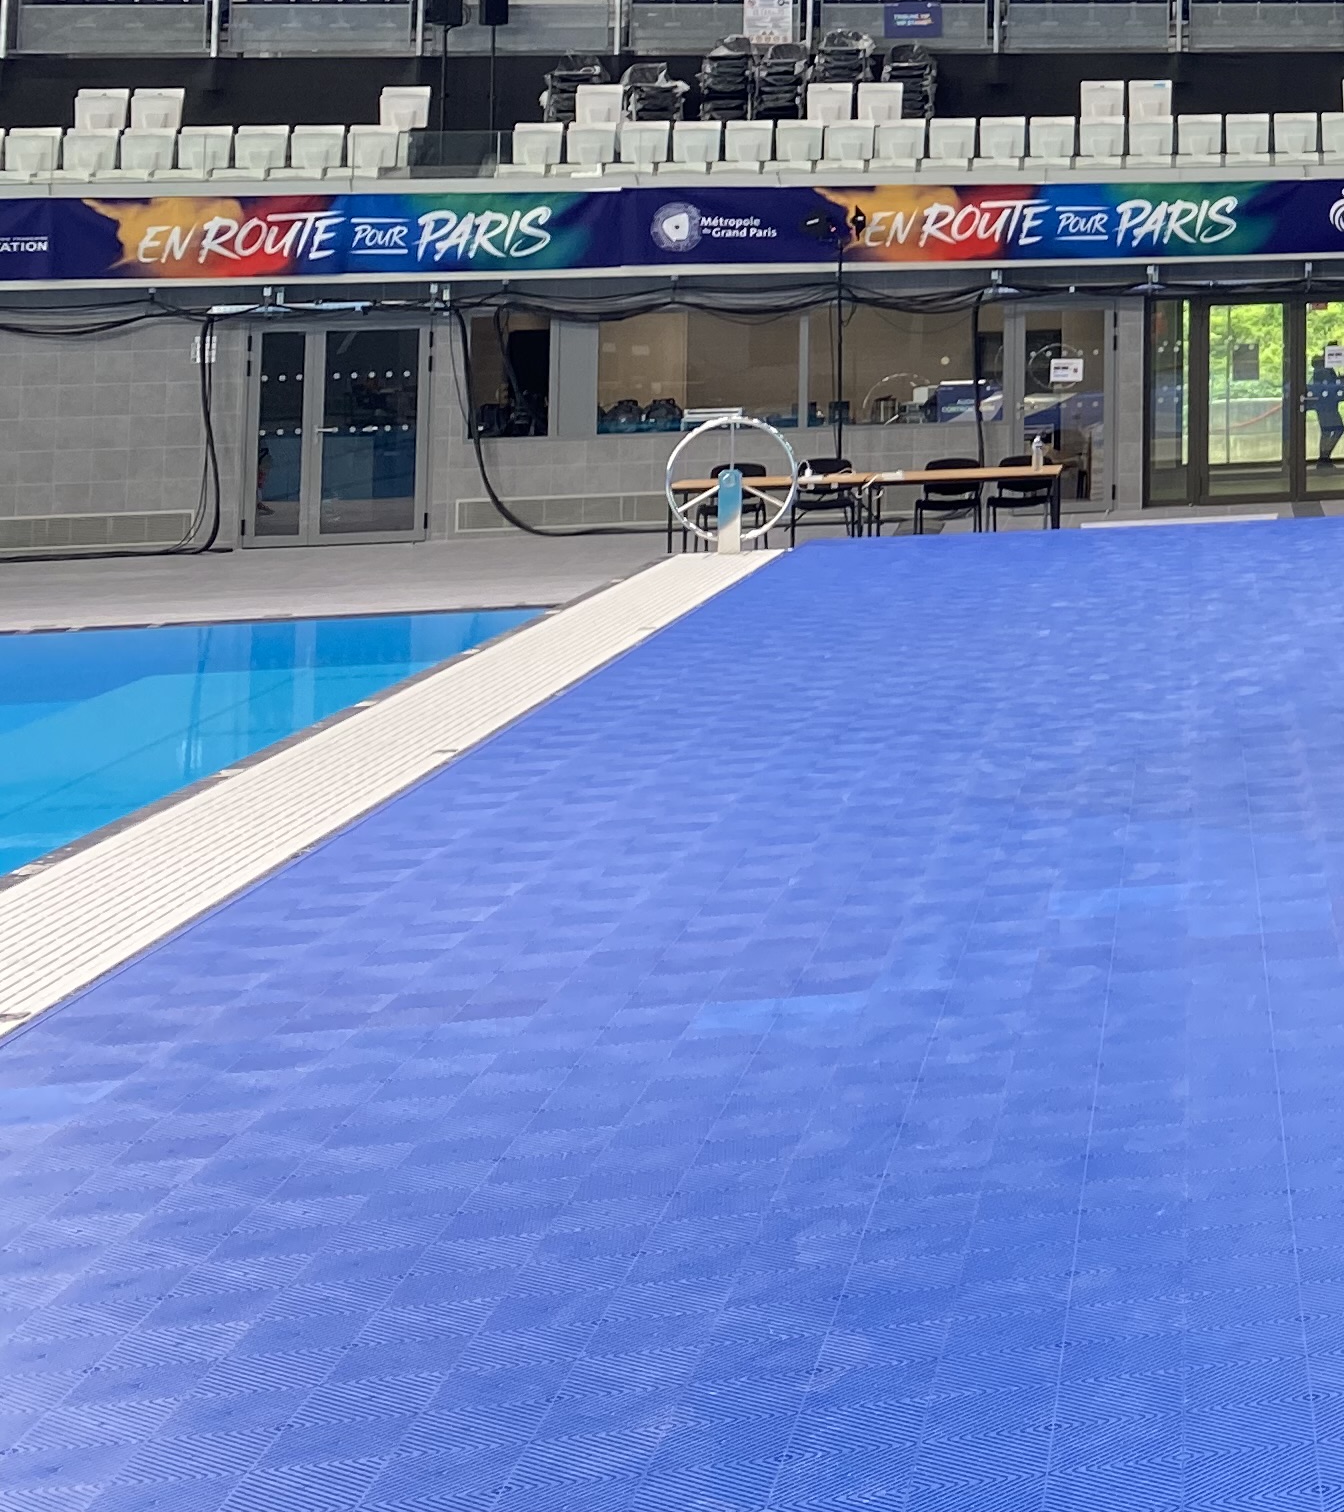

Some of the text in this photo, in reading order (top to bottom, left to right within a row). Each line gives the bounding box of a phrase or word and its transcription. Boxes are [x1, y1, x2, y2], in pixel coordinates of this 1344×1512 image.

[701, 216, 761, 230] Métropole
[865, 195, 1239, 249] EN ROUTE POUR PARIS
[138, 205, 553, 264] EN ROUTE POUR PARIS
[711, 227, 747, 238] Grand
[749, 227, 777, 238] Paris
[0, 240, 48, 252] ATION
